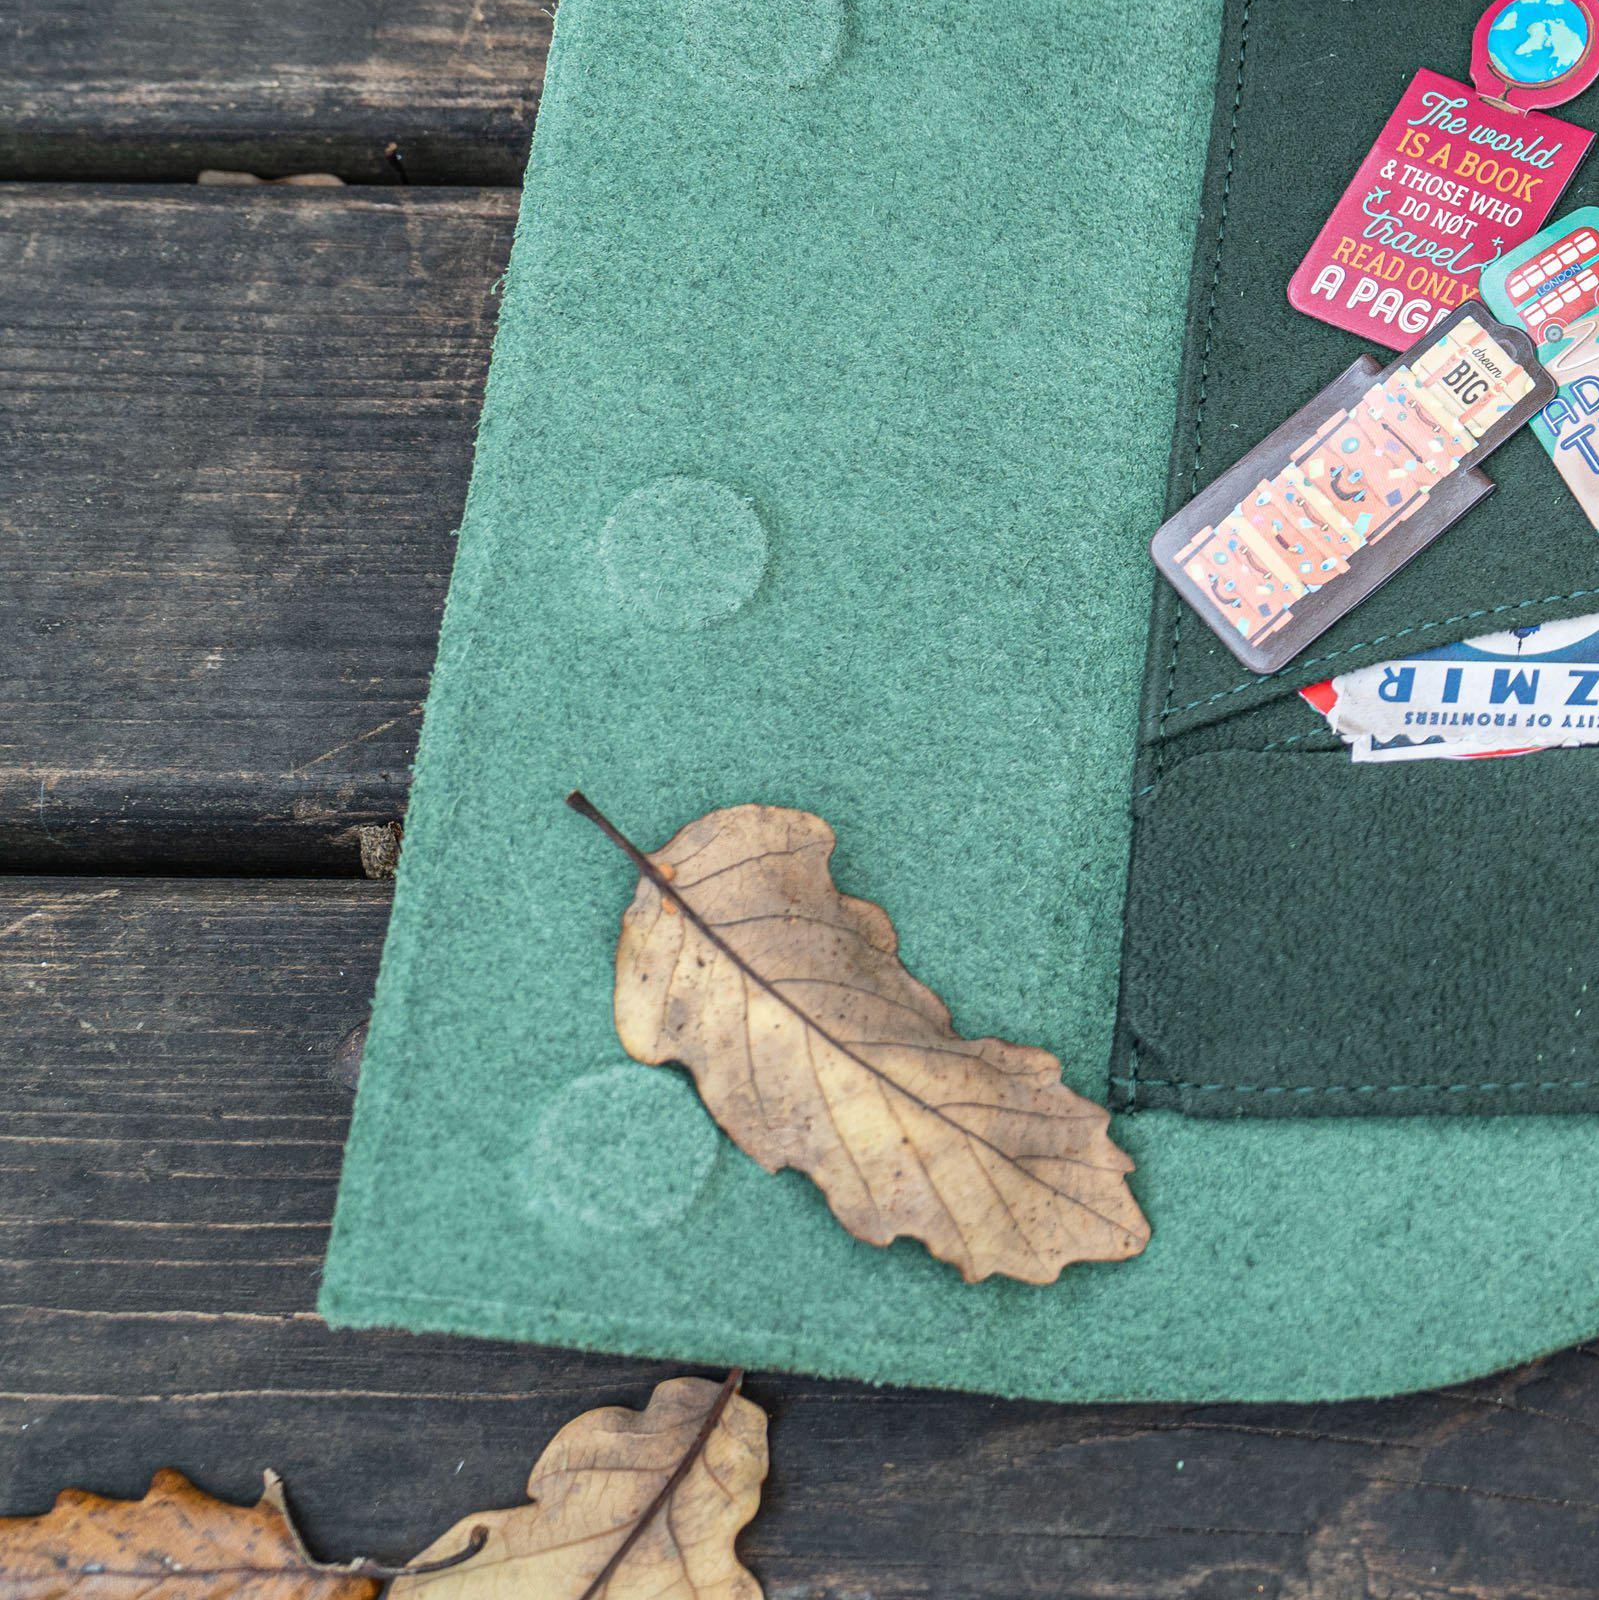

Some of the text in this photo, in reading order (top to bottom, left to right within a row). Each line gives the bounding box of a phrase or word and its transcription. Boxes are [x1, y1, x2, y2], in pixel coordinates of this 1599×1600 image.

[1407, 91, 1563, 169] The world
[1396, 128, 1544, 203] IS A BOOK
[1380, 159, 1523, 228] & THOSE WHO
[1398, 196, 1431, 223] DO
[1362, 210, 1487, 275] travel
[1310, 264, 1346, 301] A
[1333, 236, 1480, 308] READ ONLY
[1537, 264, 1581, 296] LONDON
[1442, 359, 1490, 405] BIG
[1472, 348, 1504, 379] dream
[1404, 711, 1518, 727] FRONTIERS
[1525, 713, 1552, 728] OF
